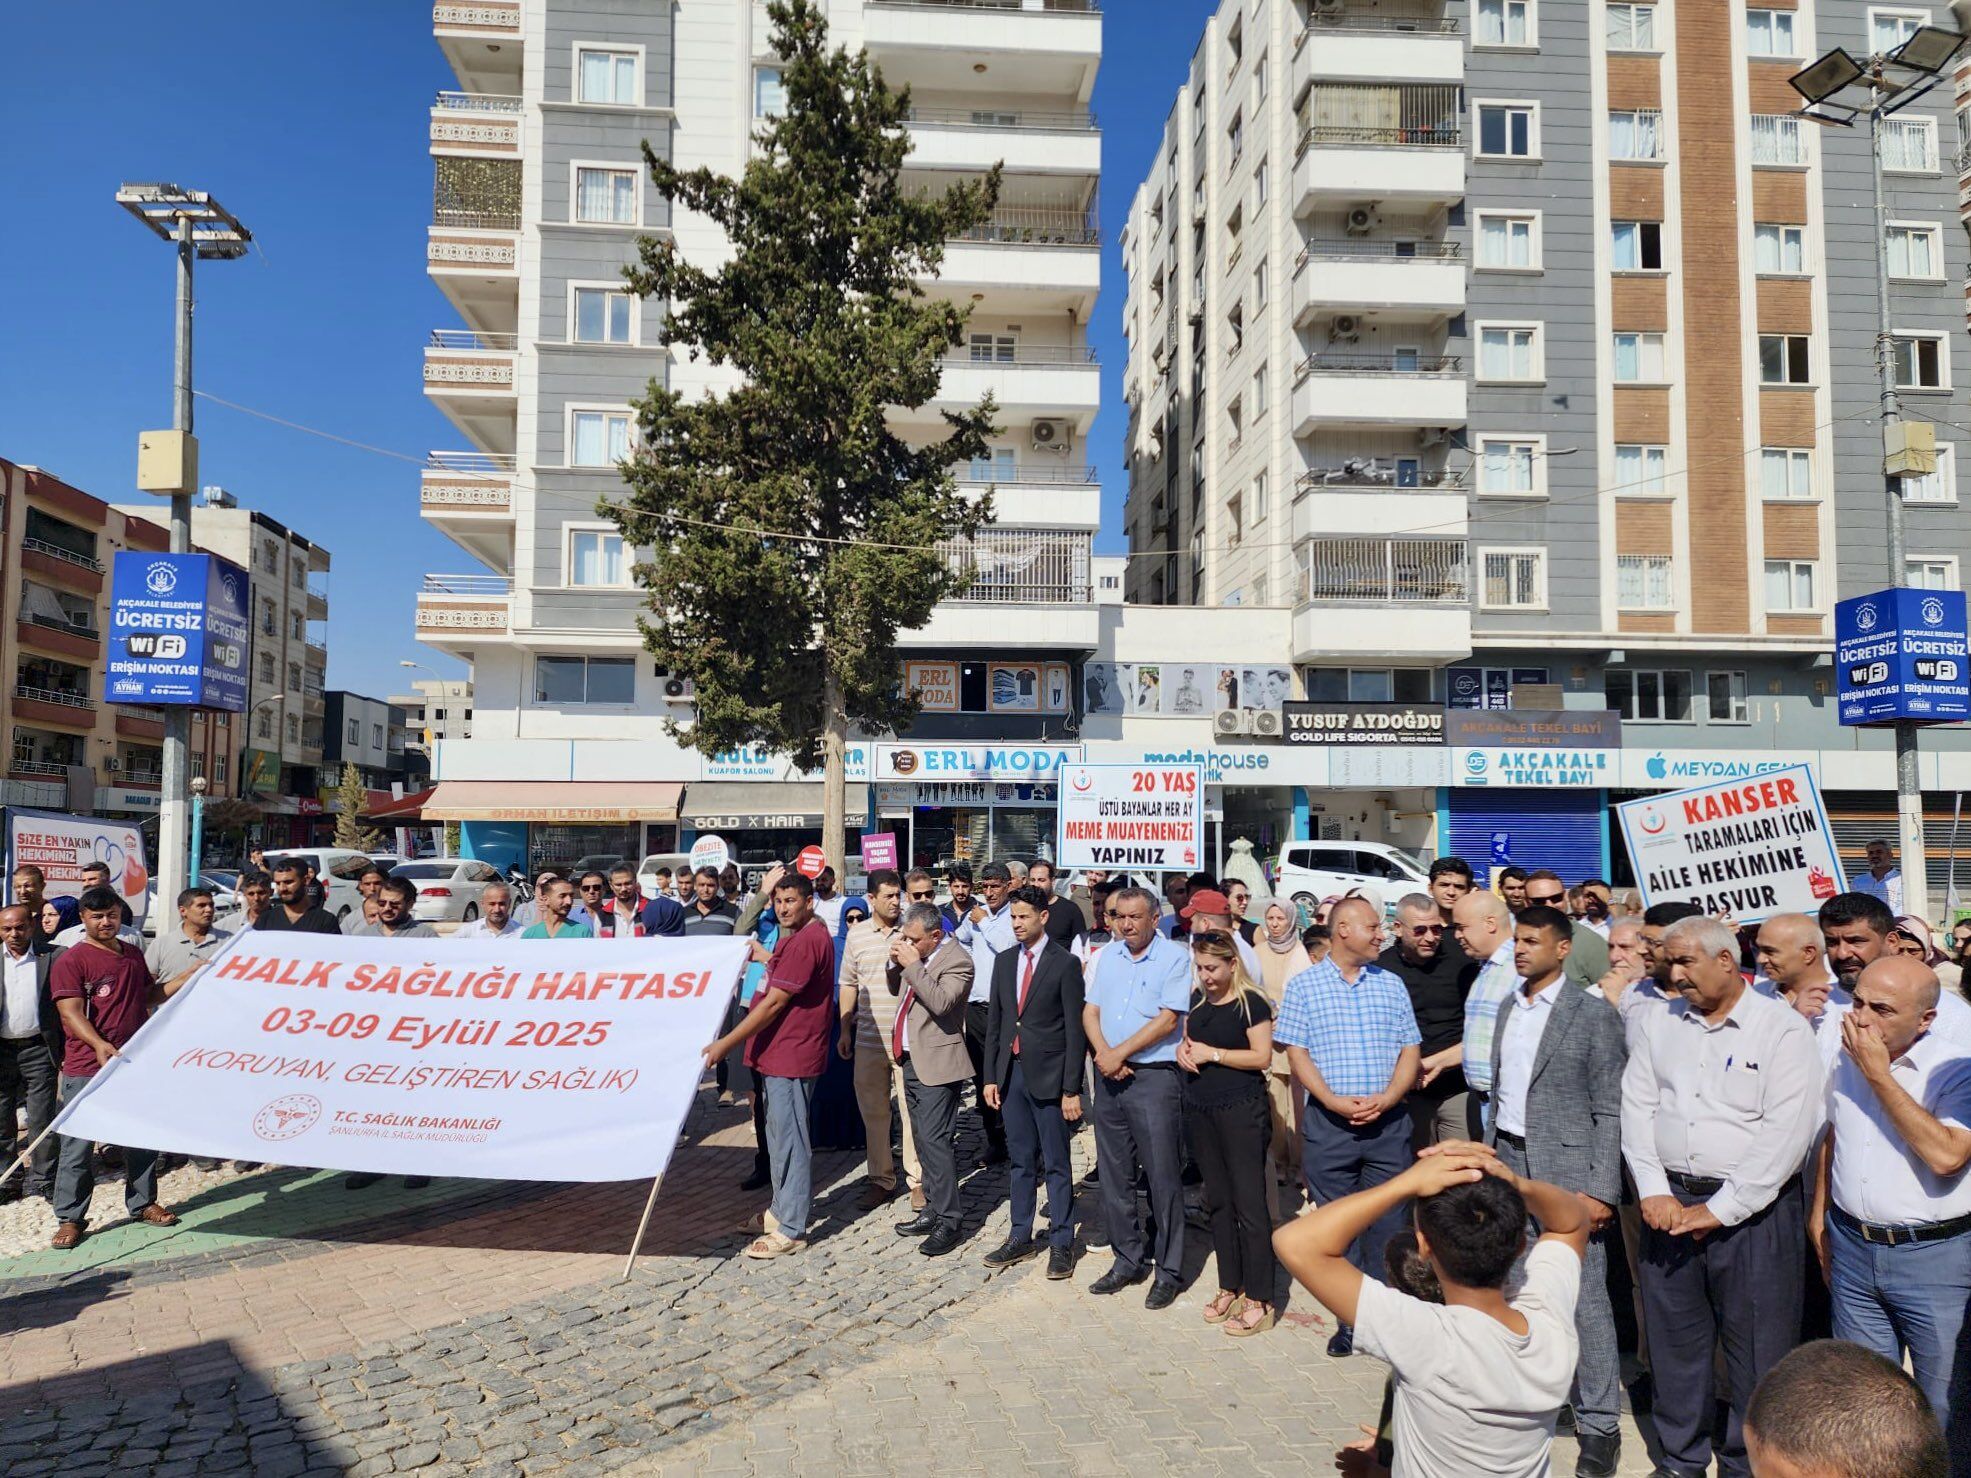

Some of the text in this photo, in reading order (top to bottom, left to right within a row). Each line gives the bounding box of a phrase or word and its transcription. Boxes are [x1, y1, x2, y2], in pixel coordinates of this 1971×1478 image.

[117, 599, 203, 610] AKÇAKALE BELEDİYESİ
[115, 609, 202, 630] ÜCRETSİZ
[207, 615, 247, 643] ÜCRETSİZ
[1840, 640, 1898, 663] ÜCRETSİZ
[1903, 638, 1966, 656] ÜCRETSİZ
[110, 661, 199, 676] ERİŞİM NOKTASI
[918, 669, 951, 686] ERL
[115, 683, 142, 691] AYHAN
[1841, 685, 1899, 702] ERİŞİM NOKTASI
[1904, 683, 1968, 695] ERİŞİM NOKTASI
[1288, 710, 1442, 730] YUSUF AYDOĞDU
[1290, 732, 1323, 742] GOLD
[1325, 733, 1346, 742] LIFE
[1461, 723, 1526, 735] AKÇAKALE
[1530, 723, 1569, 733] TEKEL
[923, 751, 976, 770] ERL
[984, 750, 1069, 771] MODA
[1499, 752, 1606, 769] AKÇAKALE
[1671, 762, 1749, 776] MEYDAN
[1132, 771, 1196, 798] 20 YAŞ
[1505, 770, 1553, 784] TEKEL
[1099, 796, 1119, 816] ÜSTÜ
[1121, 801, 1162, 816] BAYANLAR
[1165, 801, 1181, 816] HER
[1183, 801, 1193, 816] AY
[1683, 778, 1800, 825] KANSER
[491, 809, 547, 820] ORMAN
[695, 816, 740, 829] GOLD
[764, 816, 805, 827] HAIR
[1066, 822, 1102, 839] MEME
[1684, 805, 1818, 854] TARAMALARI İÇİN
[45, 835, 59, 847] EN
[60, 836, 91, 849] YAKIN
[1090, 847, 1165, 864] YAPINIZ
[1649, 845, 1807, 893] AİLE HEKİMİNE
[215, 955, 712, 1000] HALK SAĞLIĞI HAFTASI
[261, 1006, 612, 1050] 03-09 Eylül 2025
[173, 1048, 639, 1094] (KORUYAN, GELİŞTİREN SAĞLIK)
[333, 1111, 502, 1131] T.C. SAĞLIK BAKANLIĞI
[392, 1129, 423, 1141] SAĞLIK
